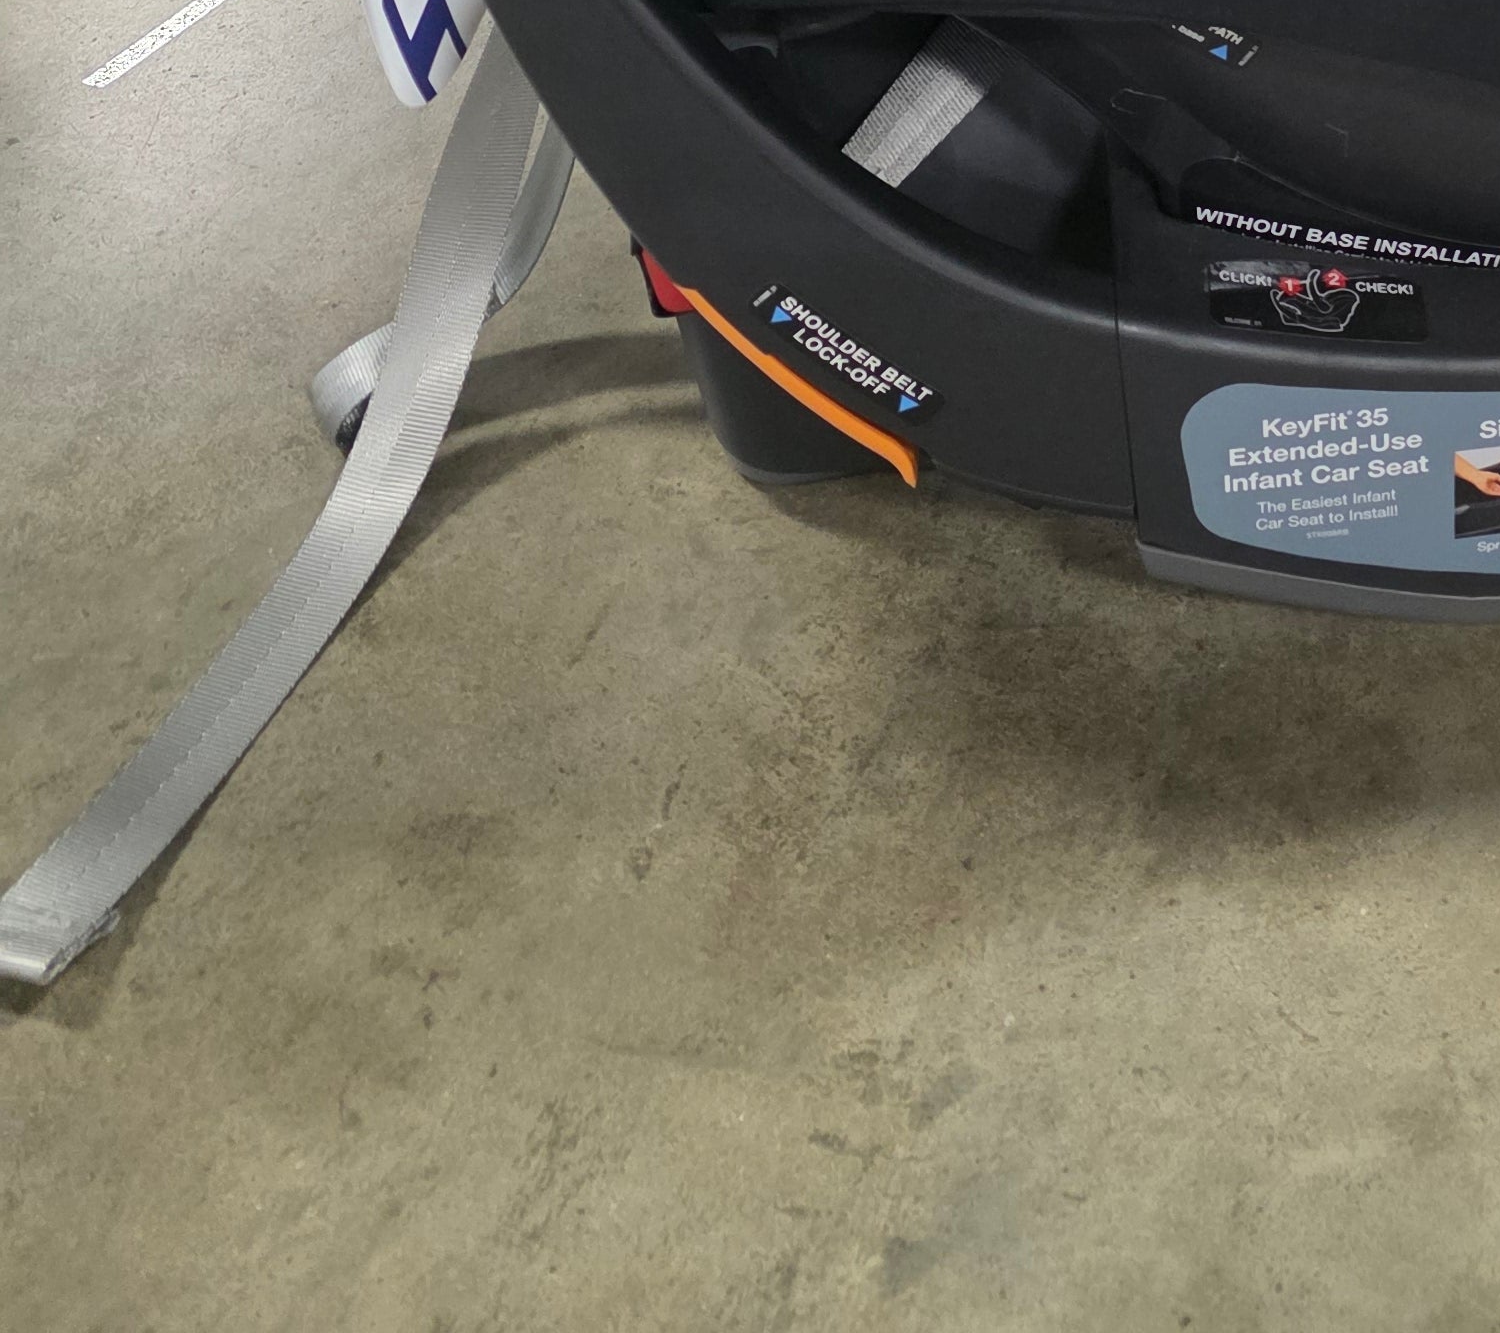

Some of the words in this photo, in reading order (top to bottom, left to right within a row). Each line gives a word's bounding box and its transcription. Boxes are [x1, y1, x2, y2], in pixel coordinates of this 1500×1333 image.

[1195, 206, 1303, 241] WITHOUT
[1305, 227, 1369, 251] BASE
[1218, 269, 1273, 288] CLICK!
[1355, 281, 1414, 296] CHECK!
[779, 296, 882, 373] SHOULDER
[880, 367, 934, 401] BELT
[792, 327, 892, 396] LOCK-OFF
[1262, 412, 1349, 438] KeyFit
[1356, 407, 1389, 428] 35
[1229, 433, 1423, 467] Extended-Use
[1224, 468, 1303, 493] Infant
[1311, 464, 1360, 485] Car
[1368, 455, 1429, 478] Seat
[1255, 518, 1284, 531] Car
[1287, 512, 1324, 527] Seat
[1329, 511, 1344, 524] to
[1349, 505, 1398, 521] Install!
[1256, 500, 1287, 514] The
[1291, 494, 1348, 511] Easiest
[1352, 489, 1397, 505] Infant
